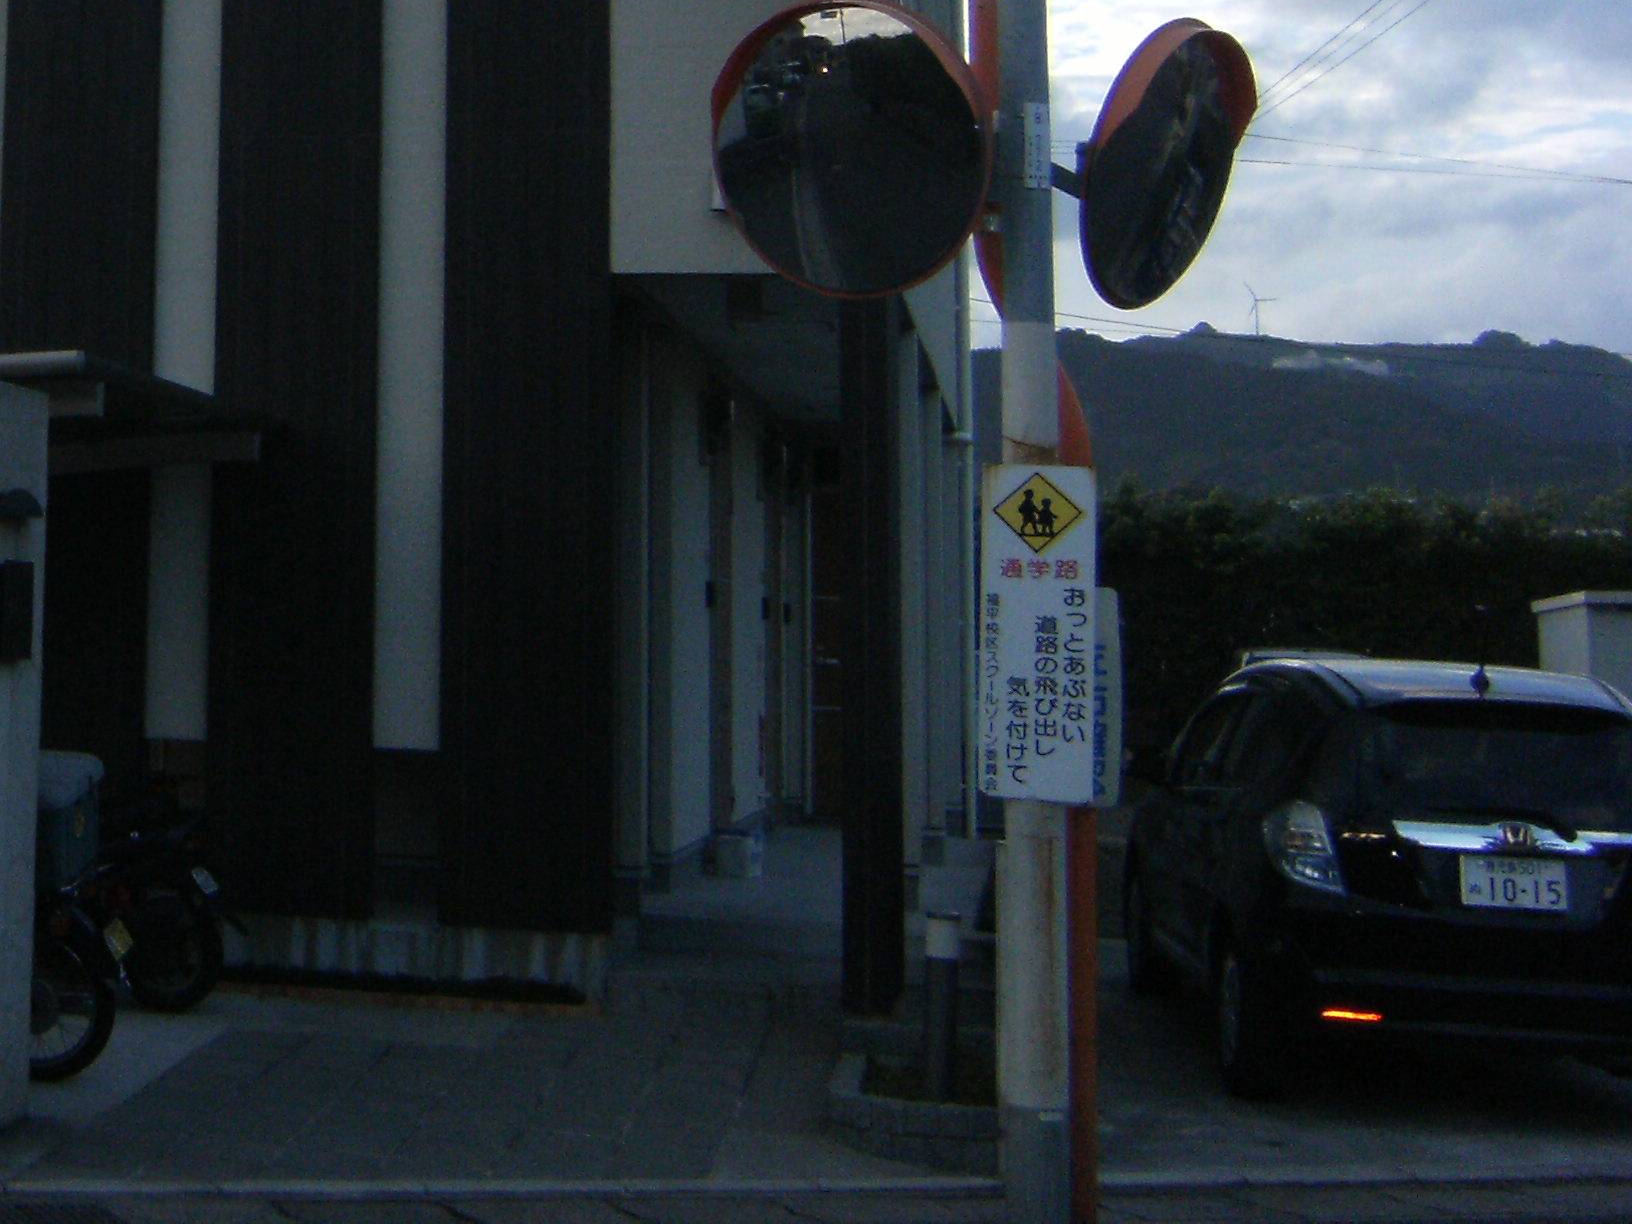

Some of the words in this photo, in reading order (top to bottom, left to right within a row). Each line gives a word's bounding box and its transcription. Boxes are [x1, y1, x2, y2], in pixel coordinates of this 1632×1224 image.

[1001, 559, 1079, 579] 通学路
[1006, 676, 1029, 783] 気を付けて
[1035, 615, 1058, 756] 道路の飛び出し
